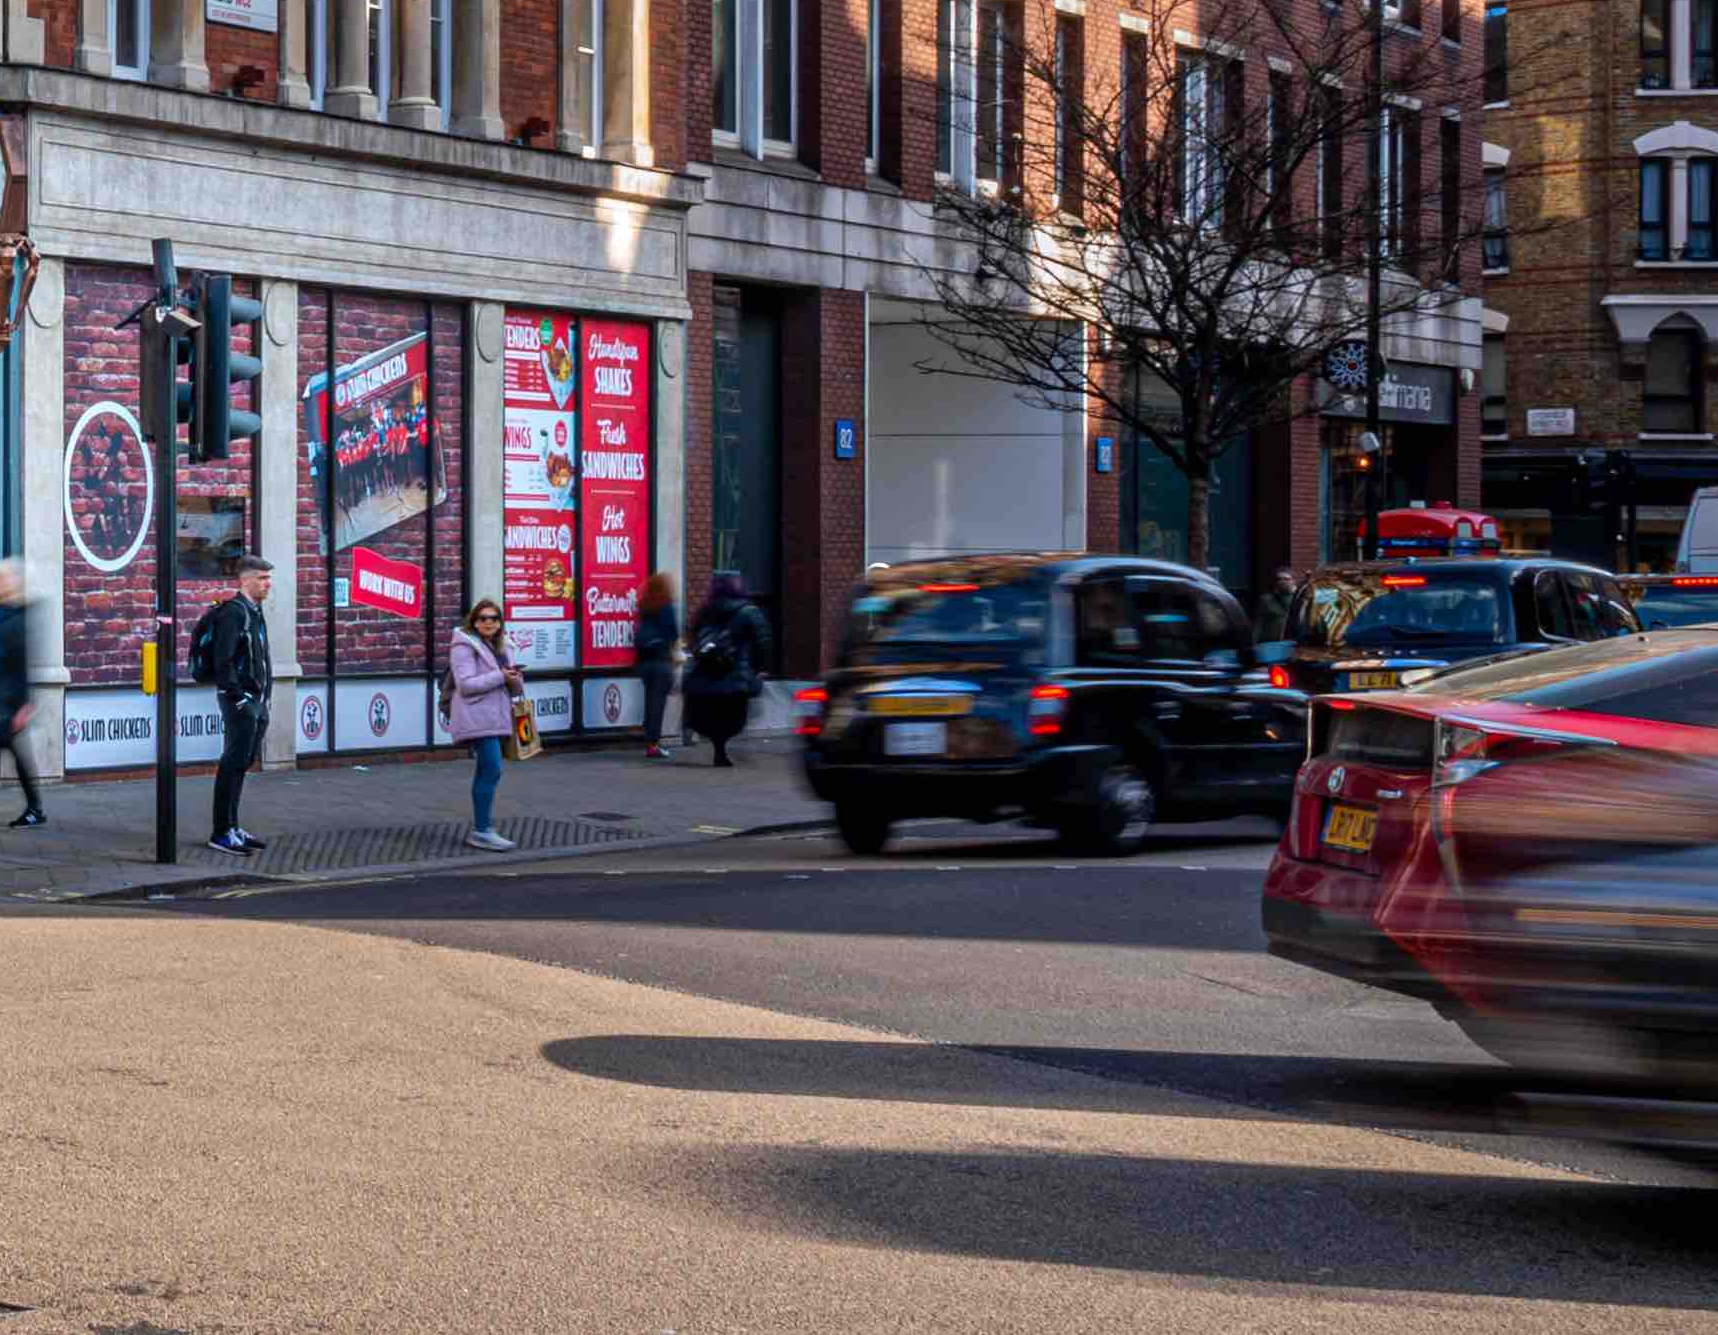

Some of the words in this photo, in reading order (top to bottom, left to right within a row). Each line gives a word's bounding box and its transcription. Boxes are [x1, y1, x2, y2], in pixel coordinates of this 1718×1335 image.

[588, 333, 639, 367] Handspun
[594, 366, 632, 396] SHAKES
[840, 428, 853, 449] 82
[582, 451, 644, 480] SANDWICHES
[602, 505, 625, 532] Hot
[506, 524, 558, 549] ANDWICHES
[596, 536, 631, 564] WINGS
[81, 719, 105, 742] SLIM
[108, 717, 152, 741] CHICKENS
[180, 714, 203, 737] SLIM
[205, 713, 226, 735] CHIC
